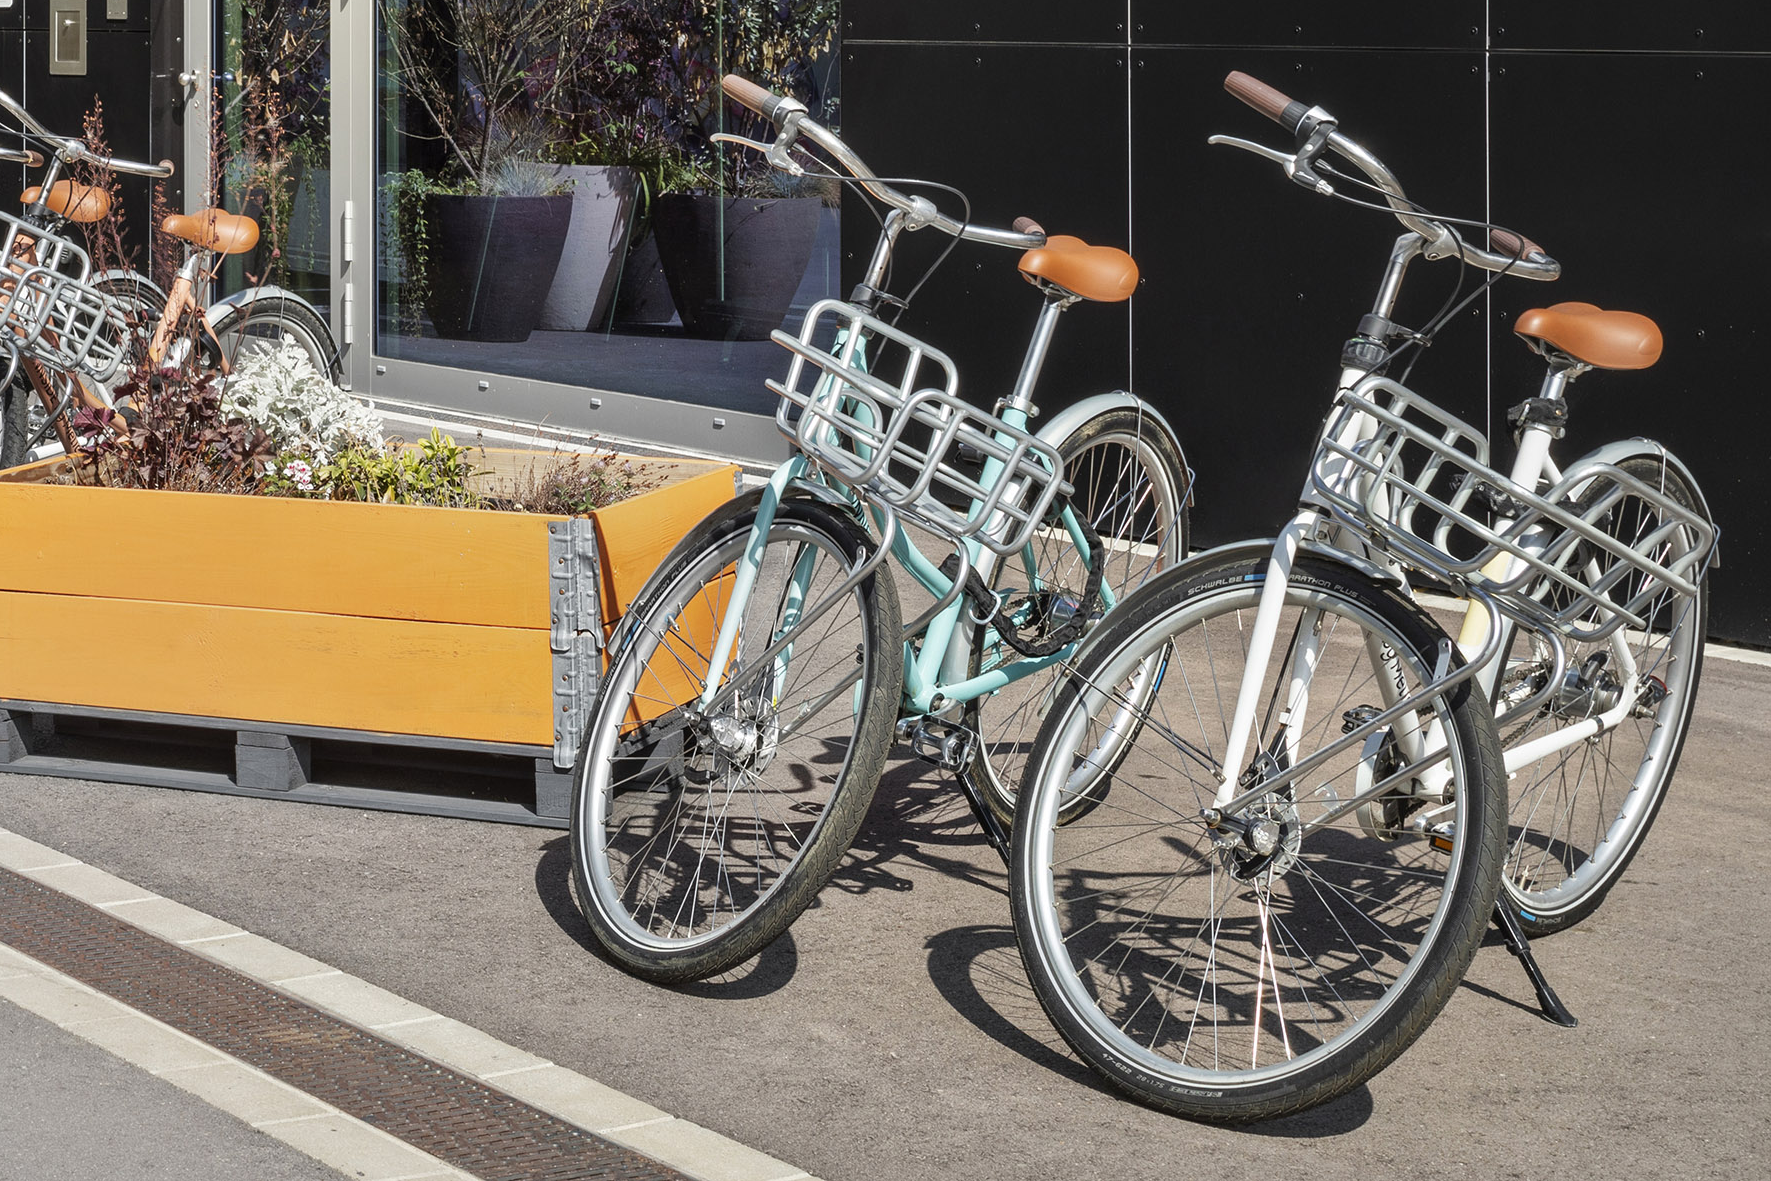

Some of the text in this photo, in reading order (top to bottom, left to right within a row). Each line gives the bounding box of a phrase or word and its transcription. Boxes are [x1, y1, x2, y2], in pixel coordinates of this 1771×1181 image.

[1187, 574, 1243, 596] SCHWALBE
[1288, 574, 1358, 598] ARATHON PLUS
